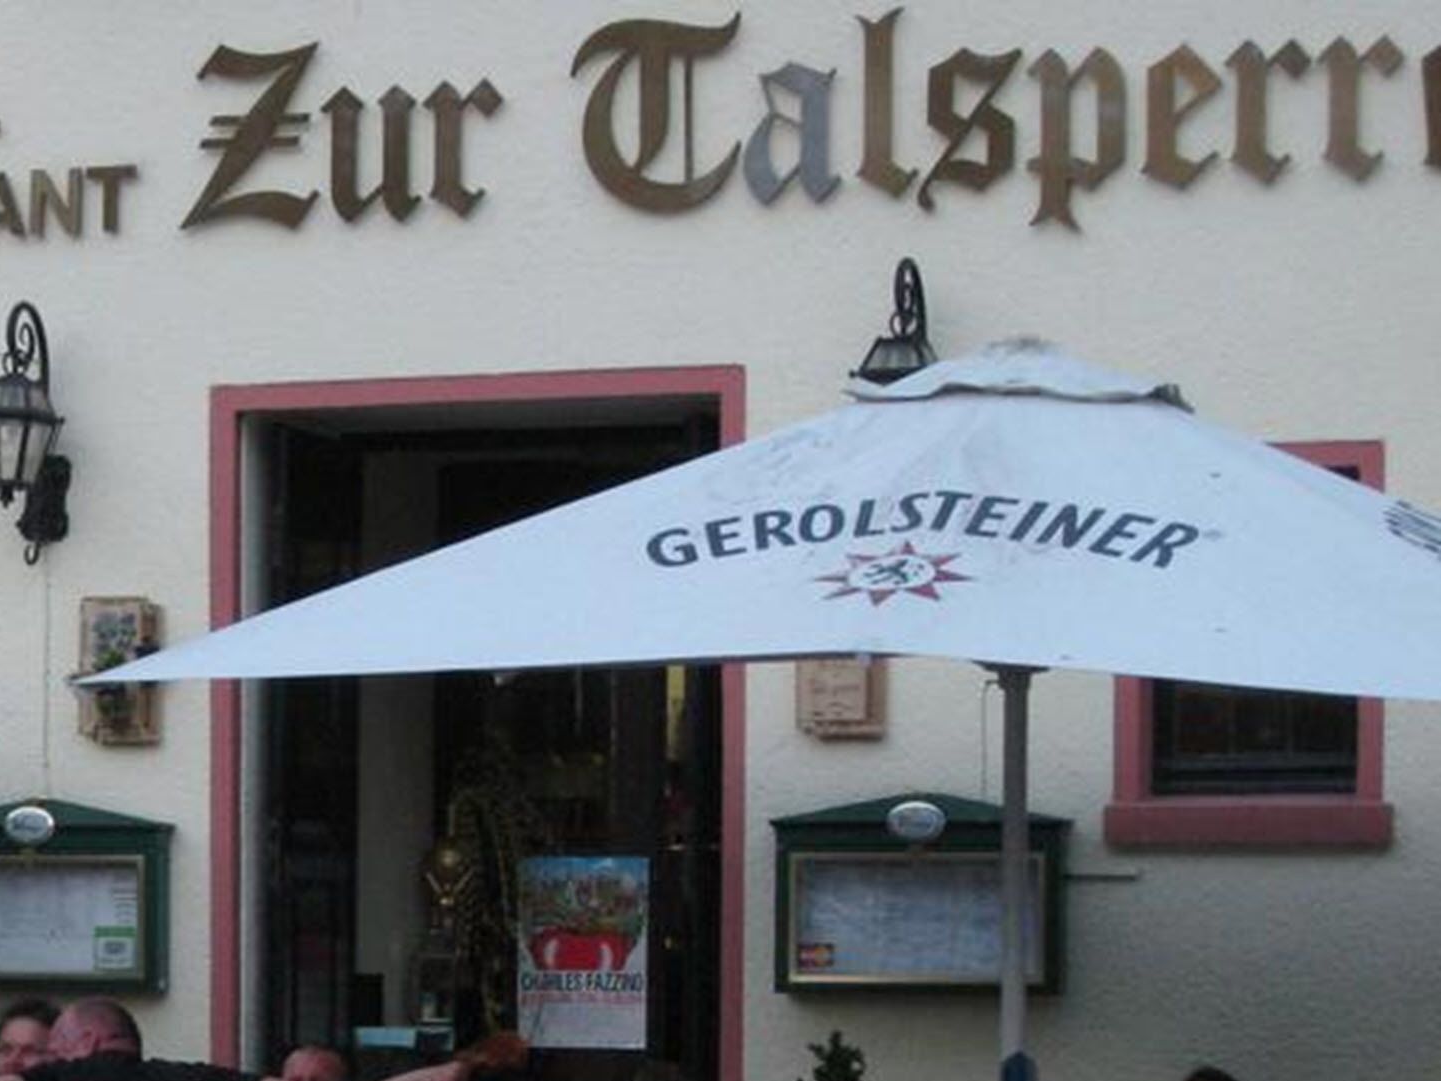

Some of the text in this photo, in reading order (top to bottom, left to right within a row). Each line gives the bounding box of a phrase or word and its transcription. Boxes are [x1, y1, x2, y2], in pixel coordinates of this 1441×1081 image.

[179, 4, 1441, 234] Zur Talsperr
[645, 489, 1200, 569] GEROLSTEINER
